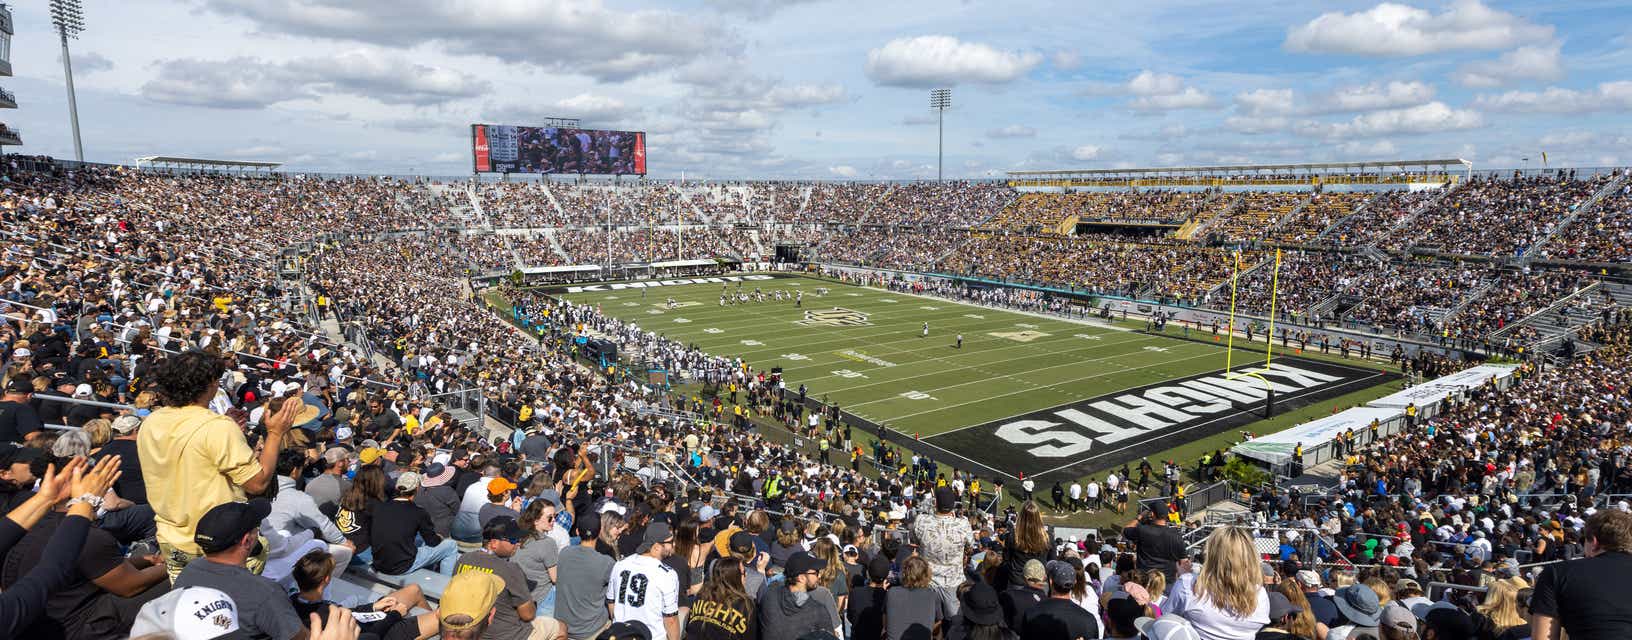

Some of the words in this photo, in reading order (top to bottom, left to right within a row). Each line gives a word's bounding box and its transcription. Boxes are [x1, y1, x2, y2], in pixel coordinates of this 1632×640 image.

[993, 362, 1346, 458] KNIGHTS
[618, 569, 649, 609] 19
[690, 599, 747, 634] NIGHTS
